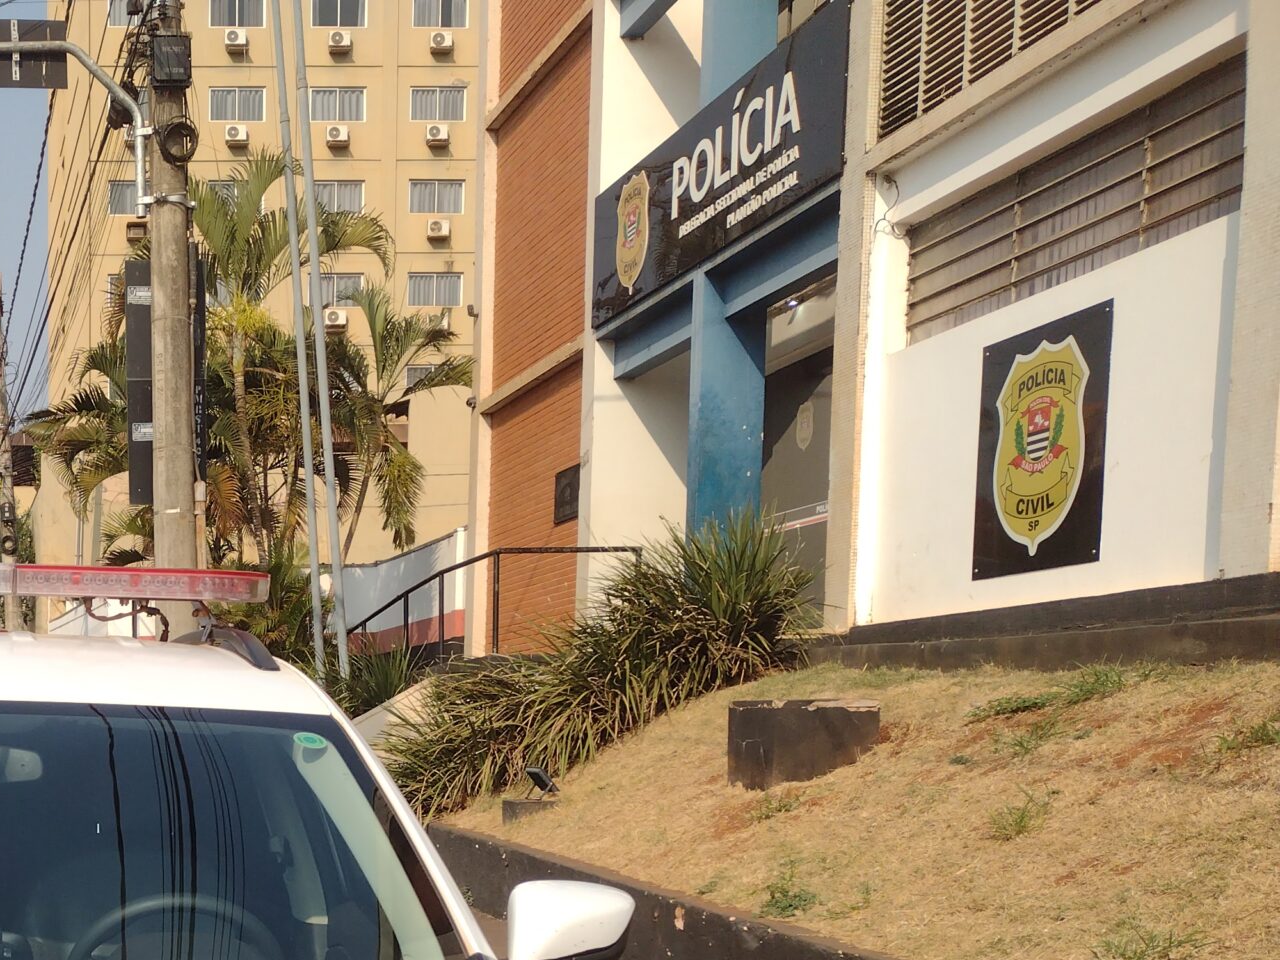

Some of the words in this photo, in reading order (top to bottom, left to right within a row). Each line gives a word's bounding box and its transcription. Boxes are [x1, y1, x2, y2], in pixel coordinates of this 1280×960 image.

[670, 70, 801, 221] POLÍCIA
[678, 203, 716, 240] DELEGACIA
[755, 167, 768, 187] DE
[767, 144, 800, 179] POLÍCIA
[726, 195, 762, 229] PLANTÃO
[762, 170, 799, 205] POLICIAL
[1017, 364, 1067, 400] POLÍCIA
[1015, 492, 1055, 516] CIVIL
[1028, 520, 1040, 532] SP
